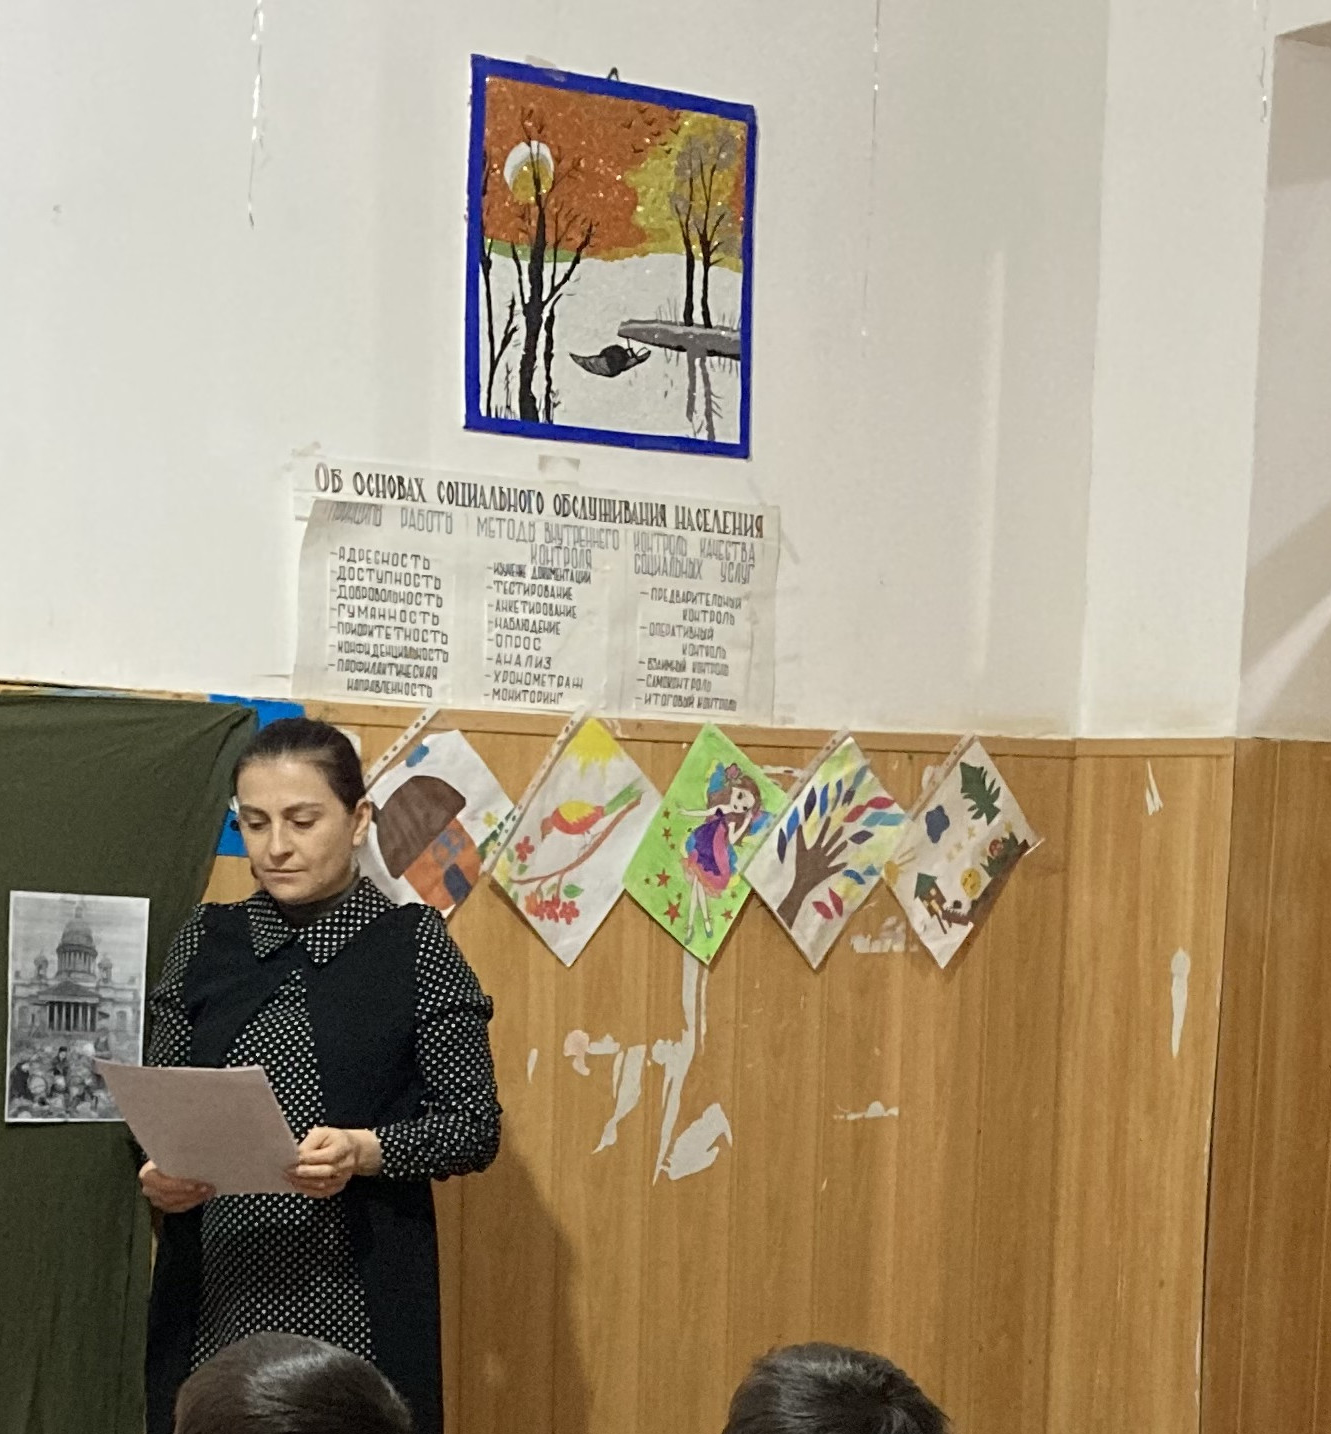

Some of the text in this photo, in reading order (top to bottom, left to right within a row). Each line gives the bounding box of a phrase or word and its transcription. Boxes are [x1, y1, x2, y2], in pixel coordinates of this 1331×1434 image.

[352, 471, 427, 504] ОСНОВАХ
[437, 480, 544, 516] СОЦИАЛЬНОГО
[553, 493, 667, 528] ОБСЛУЖИВАНИЯ
[674, 504, 764, 538] НАСЕЛЕНИЯ
[400, 507, 454, 534] РАБОТЫ
[476, 516, 620, 551] МЕТОДЫ ВНУТРЕННЕГО
[530, 544, 592, 570] КОНТРОЛЯ
[700, 538, 756, 564] КАЧЕСТВА
[634, 553, 756, 584] СОЦИАЛЬНЫХ УСЛУГ
[682, 608, 736, 626] КОНТРОЛЬ
[346, 678, 433, 698] НАПРАВЛЕННОСТЬ
